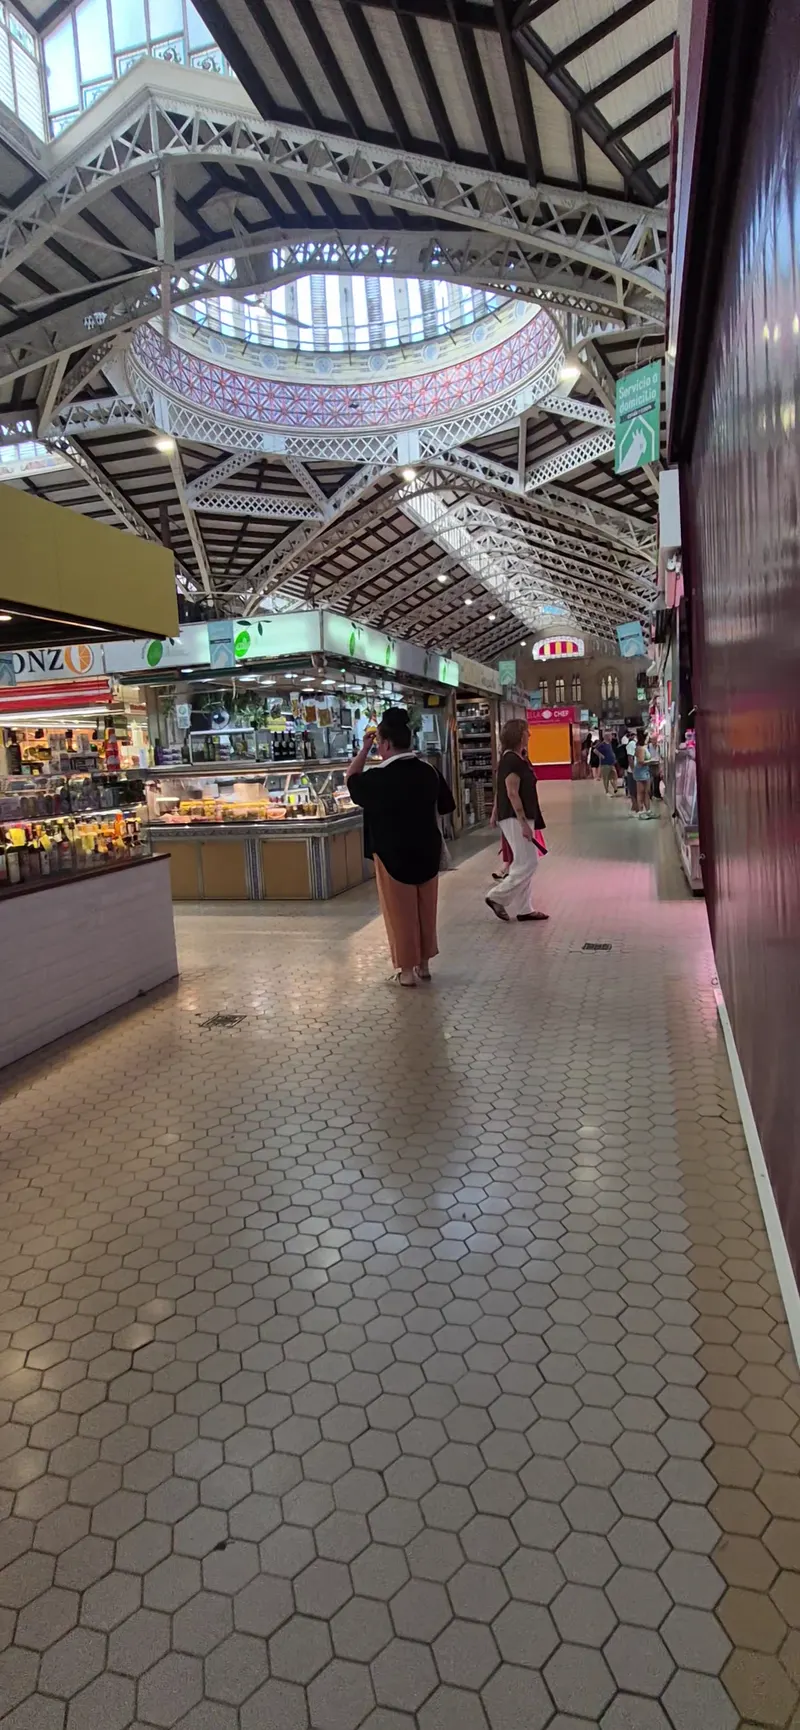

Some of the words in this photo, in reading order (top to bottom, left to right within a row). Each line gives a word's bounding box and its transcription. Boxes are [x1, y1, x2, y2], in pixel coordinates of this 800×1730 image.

[619, 376, 651, 399] Servicio
[620, 387, 657, 414] domicilio
[553, 710, 569, 718] CHEF
